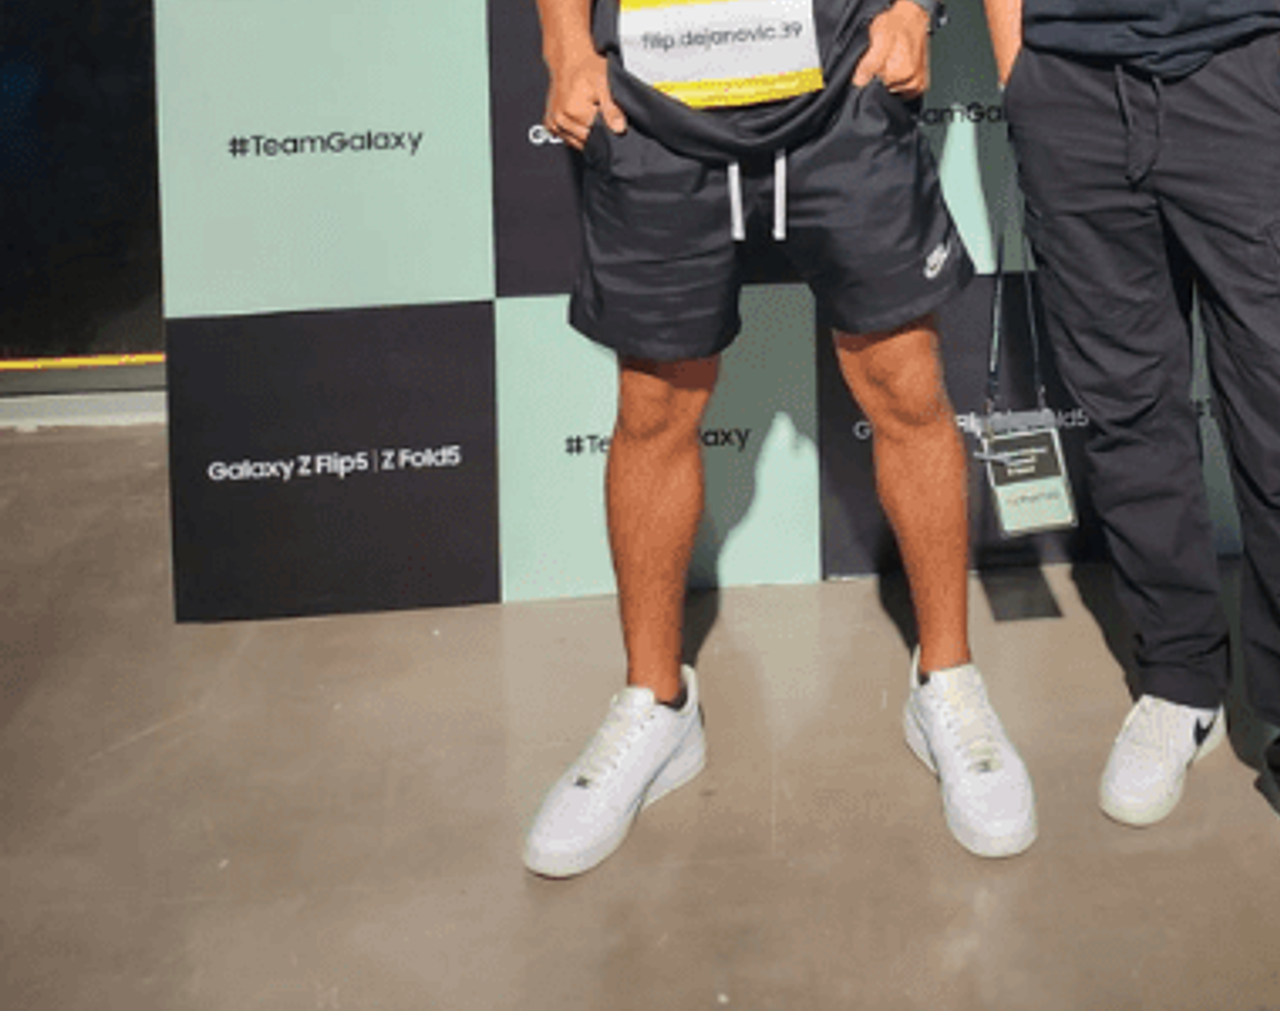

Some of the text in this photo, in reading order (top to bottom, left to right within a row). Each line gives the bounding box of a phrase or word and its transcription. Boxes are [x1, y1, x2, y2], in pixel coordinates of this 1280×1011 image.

[229, 131, 422, 157] #TeamGalaxy
[565, 425, 751, 455] #Teaxy
[208, 445, 461, 480] Galaxy Z Flip5 Z Fold5
